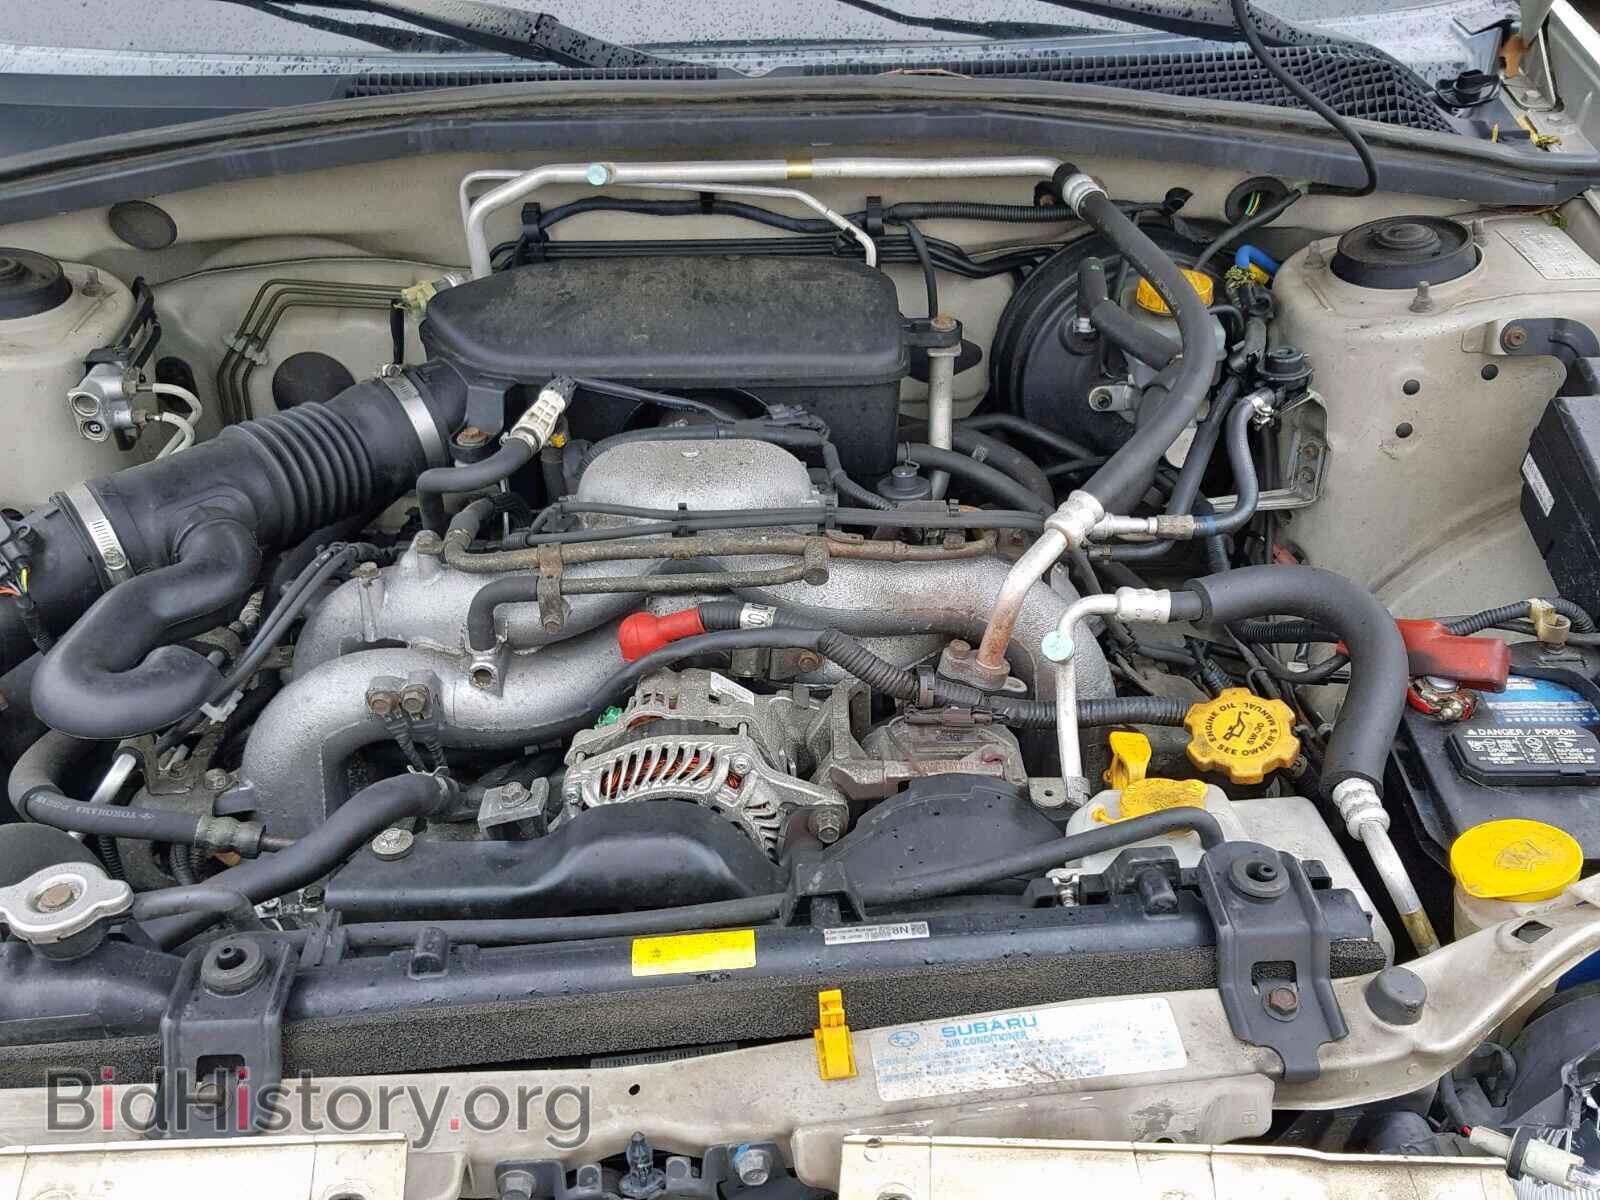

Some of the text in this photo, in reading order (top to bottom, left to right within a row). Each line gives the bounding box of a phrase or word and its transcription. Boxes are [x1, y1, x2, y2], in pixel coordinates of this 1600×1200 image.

[1205, 702, 1237, 743] ENGINE OIL
[1217, 702, 1278, 756] SEE OWNER'S MANUAL
[1478, 728, 1523, 737] DANGER
[1534, 728, 1577, 737] POISON
[941, 1014, 1037, 1038] SUBARU
[945, 1031, 1029, 1049] AIR CONDITIONER
